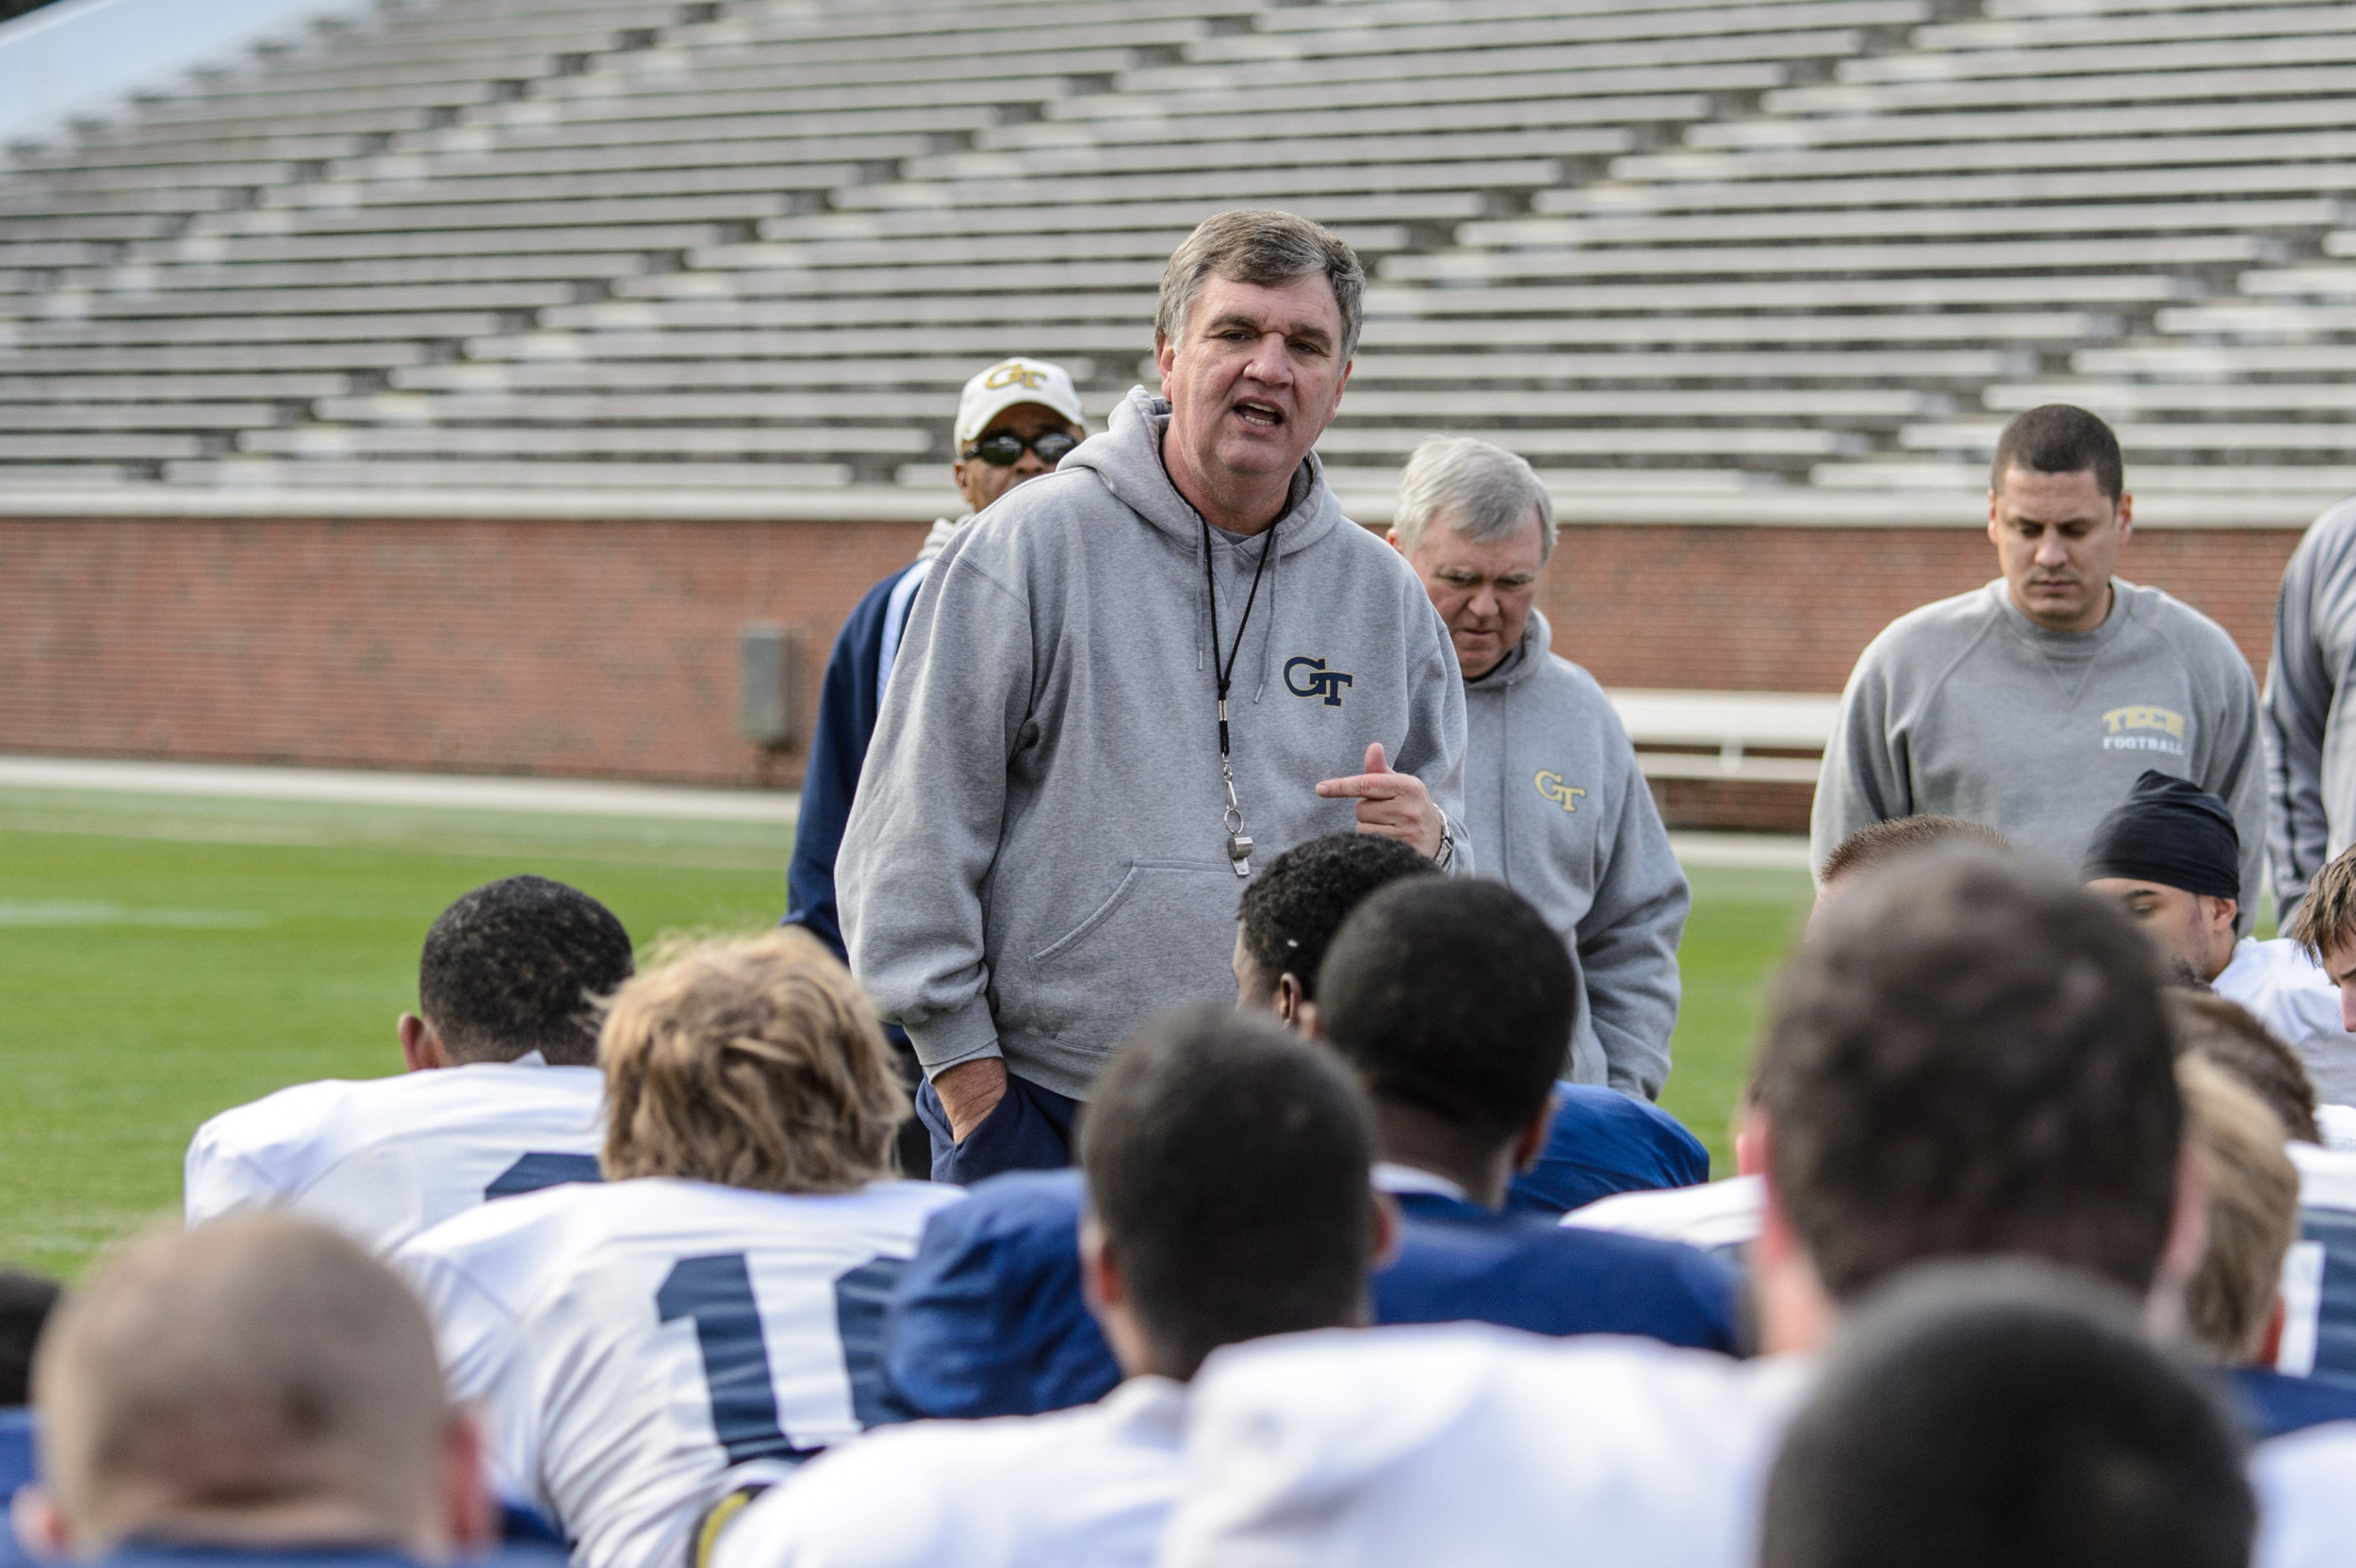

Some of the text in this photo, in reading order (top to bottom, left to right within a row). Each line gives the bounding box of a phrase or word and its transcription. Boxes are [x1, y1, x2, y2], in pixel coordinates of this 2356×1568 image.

[985, 363, 1048, 389] GT
[1283, 655, 1354, 708] GT
[2102, 705, 2184, 740] TECH
[2102, 735, 2184, 756] FOOTBALL
[1533, 769, 1587, 813] GT
